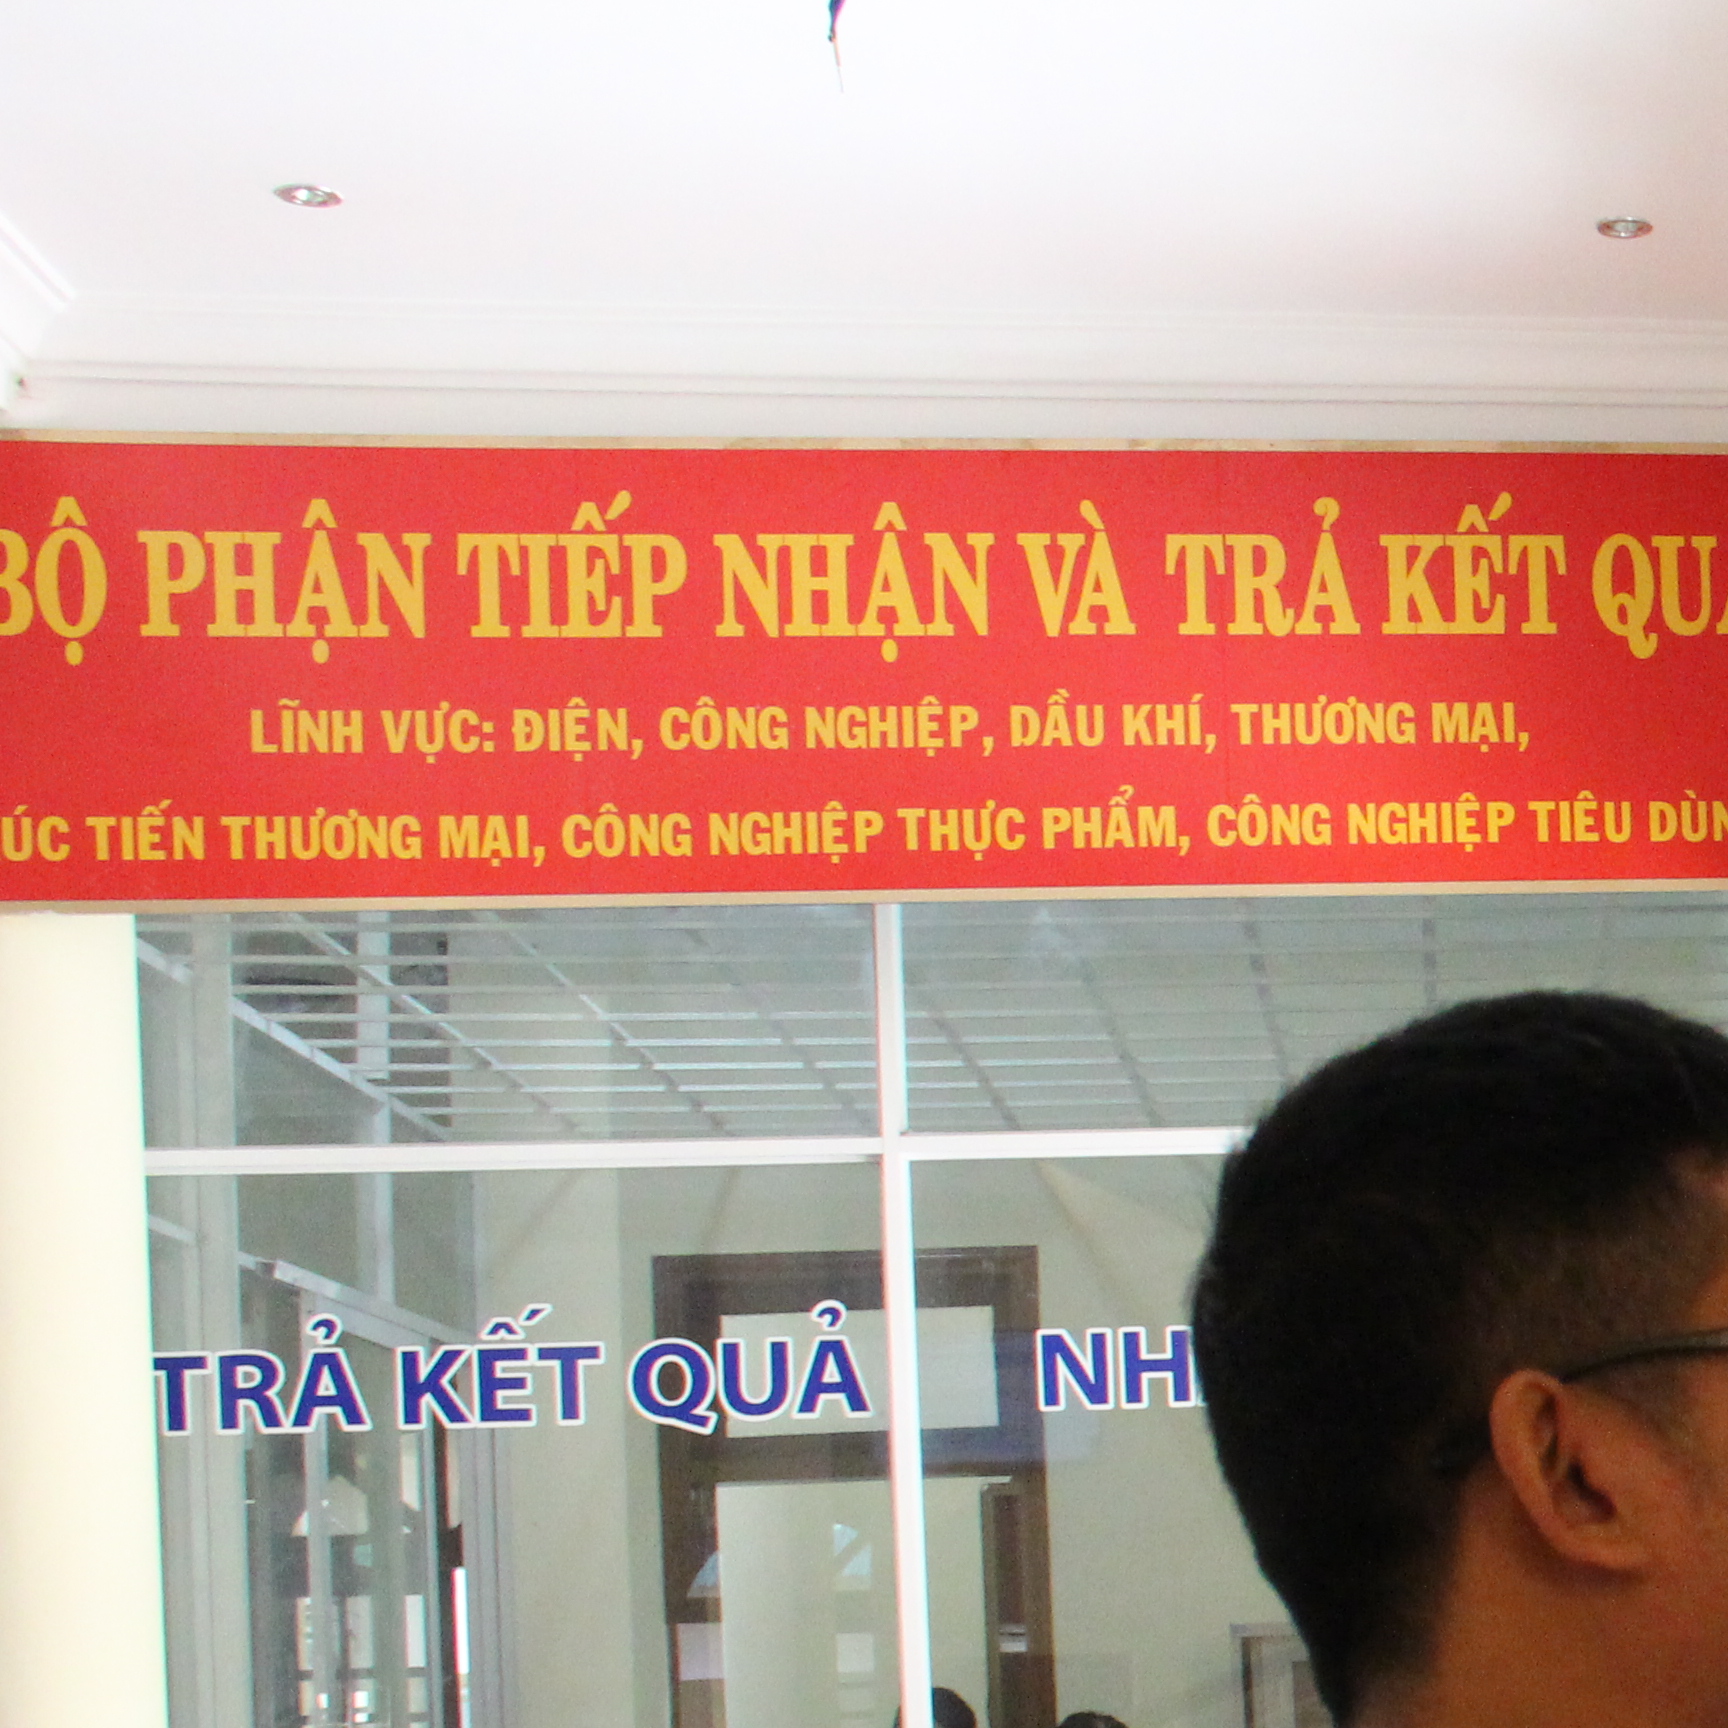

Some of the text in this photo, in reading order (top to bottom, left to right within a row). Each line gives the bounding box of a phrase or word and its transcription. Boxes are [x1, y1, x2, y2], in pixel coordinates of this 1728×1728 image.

[138, 498, 432, 664] PHẬN
[457, 489, 687, 639] TIẾP
[714, 501, 995, 663] NHẬN
[1017, 499, 1136, 638] VÀ
[1166, 497, 1360, 637] TRẢ
[1380, 492, 1566, 635] KẾT
[251, 688, 1530, 763] LĨNH VỰC: ĐIỆN, CÔNG NGHIỆP, DẦU KHÍ, THƯƠNG MẠI,
[0, 805, 70, 862] ÚC
[86, 799, 204, 861] TIẾN
[221, 806, 423, 860] THƯƠNG
[439, 814, 546, 867] MẠI,
[562, 802, 693, 859] CÔNG
[709, 800, 885, 864] NGHIỆP
[897, 799, 1026, 861] THỰC
[1042, 784, 1191, 856] PHẨM,
[1207, 793, 1333, 848] CÔNG
[1347, 791, 1516, 853] NGHIỆP
[1528, 790, 1633, 843] TIÊU
[152, 1299, 873, 1436] TRẢ KẾT QUẢ
[1036, 1324, 1206, 1411] NH
